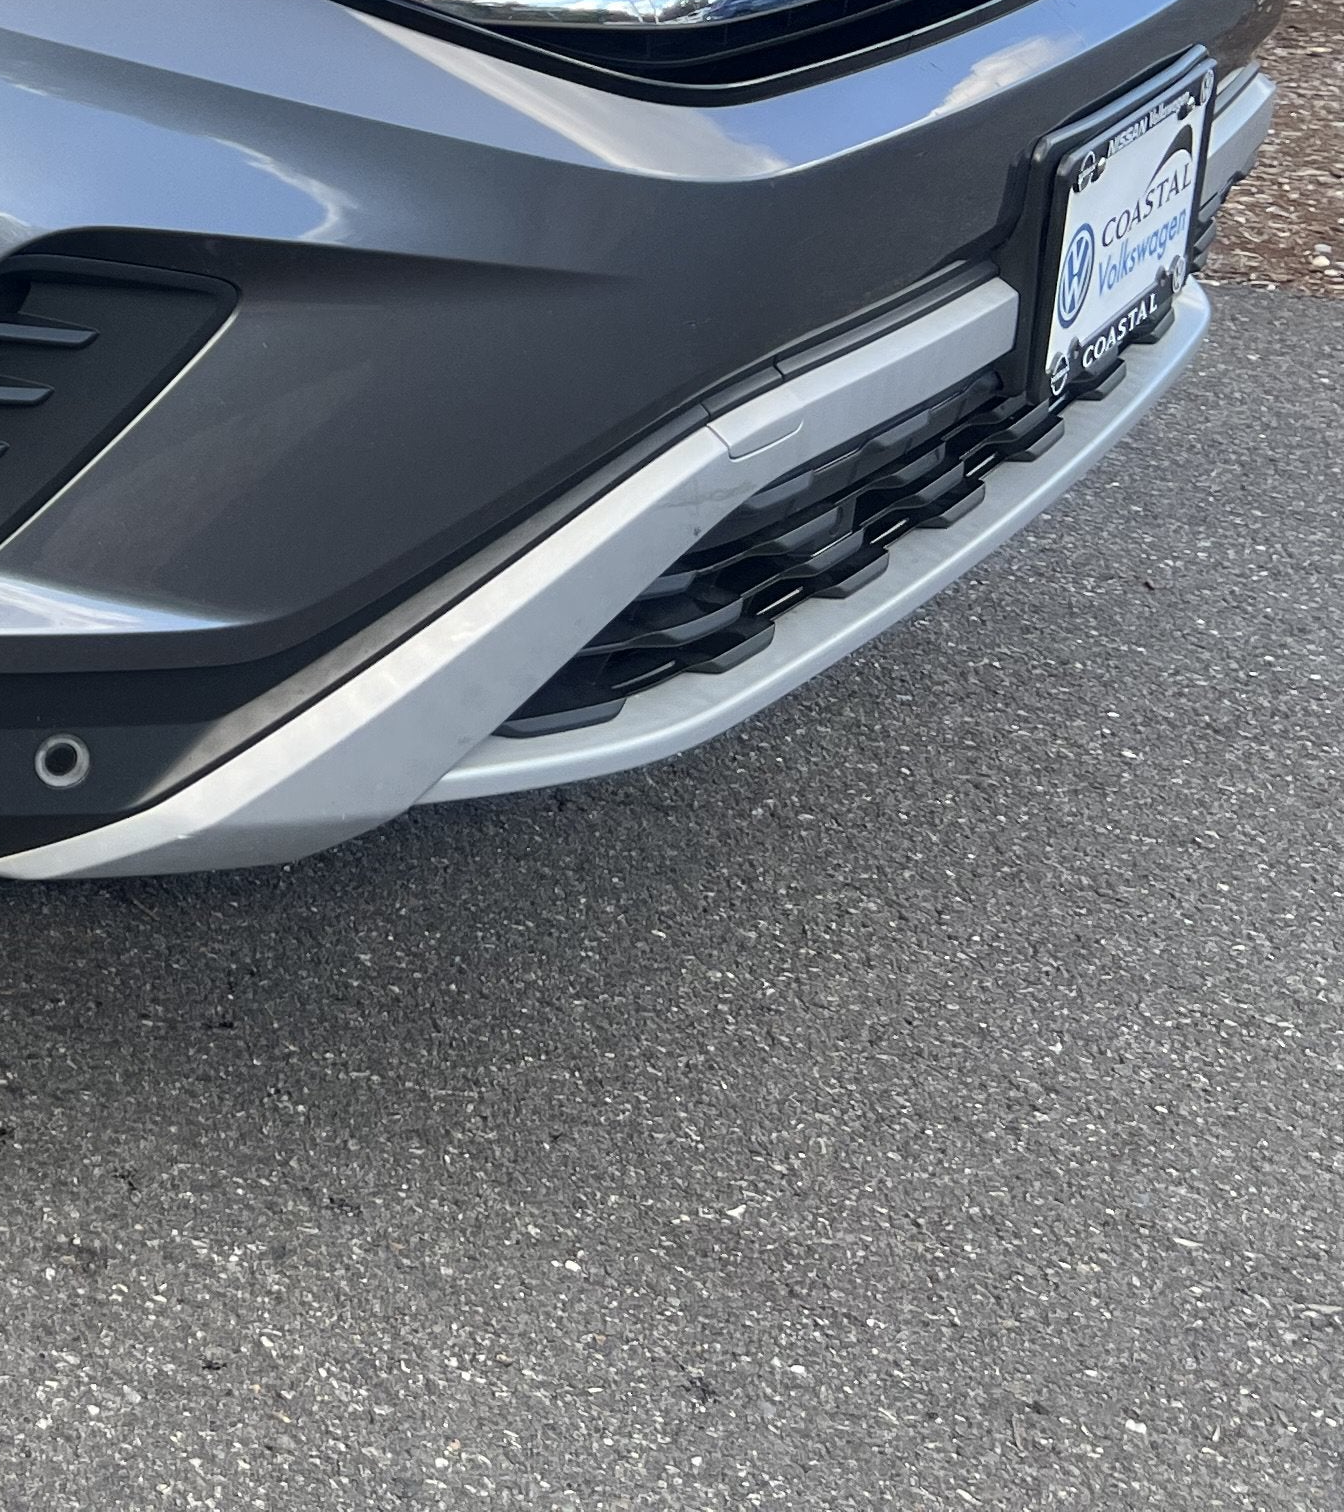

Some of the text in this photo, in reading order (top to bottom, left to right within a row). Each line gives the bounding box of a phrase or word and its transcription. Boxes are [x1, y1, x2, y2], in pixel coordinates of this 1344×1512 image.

[1107, 116, 1148, 157] NISSAN
[1100, 161, 1193, 248] COASTAL
[1096, 208, 1188, 297] Volkswagen
[1081, 292, 1159, 369] COASTAL
